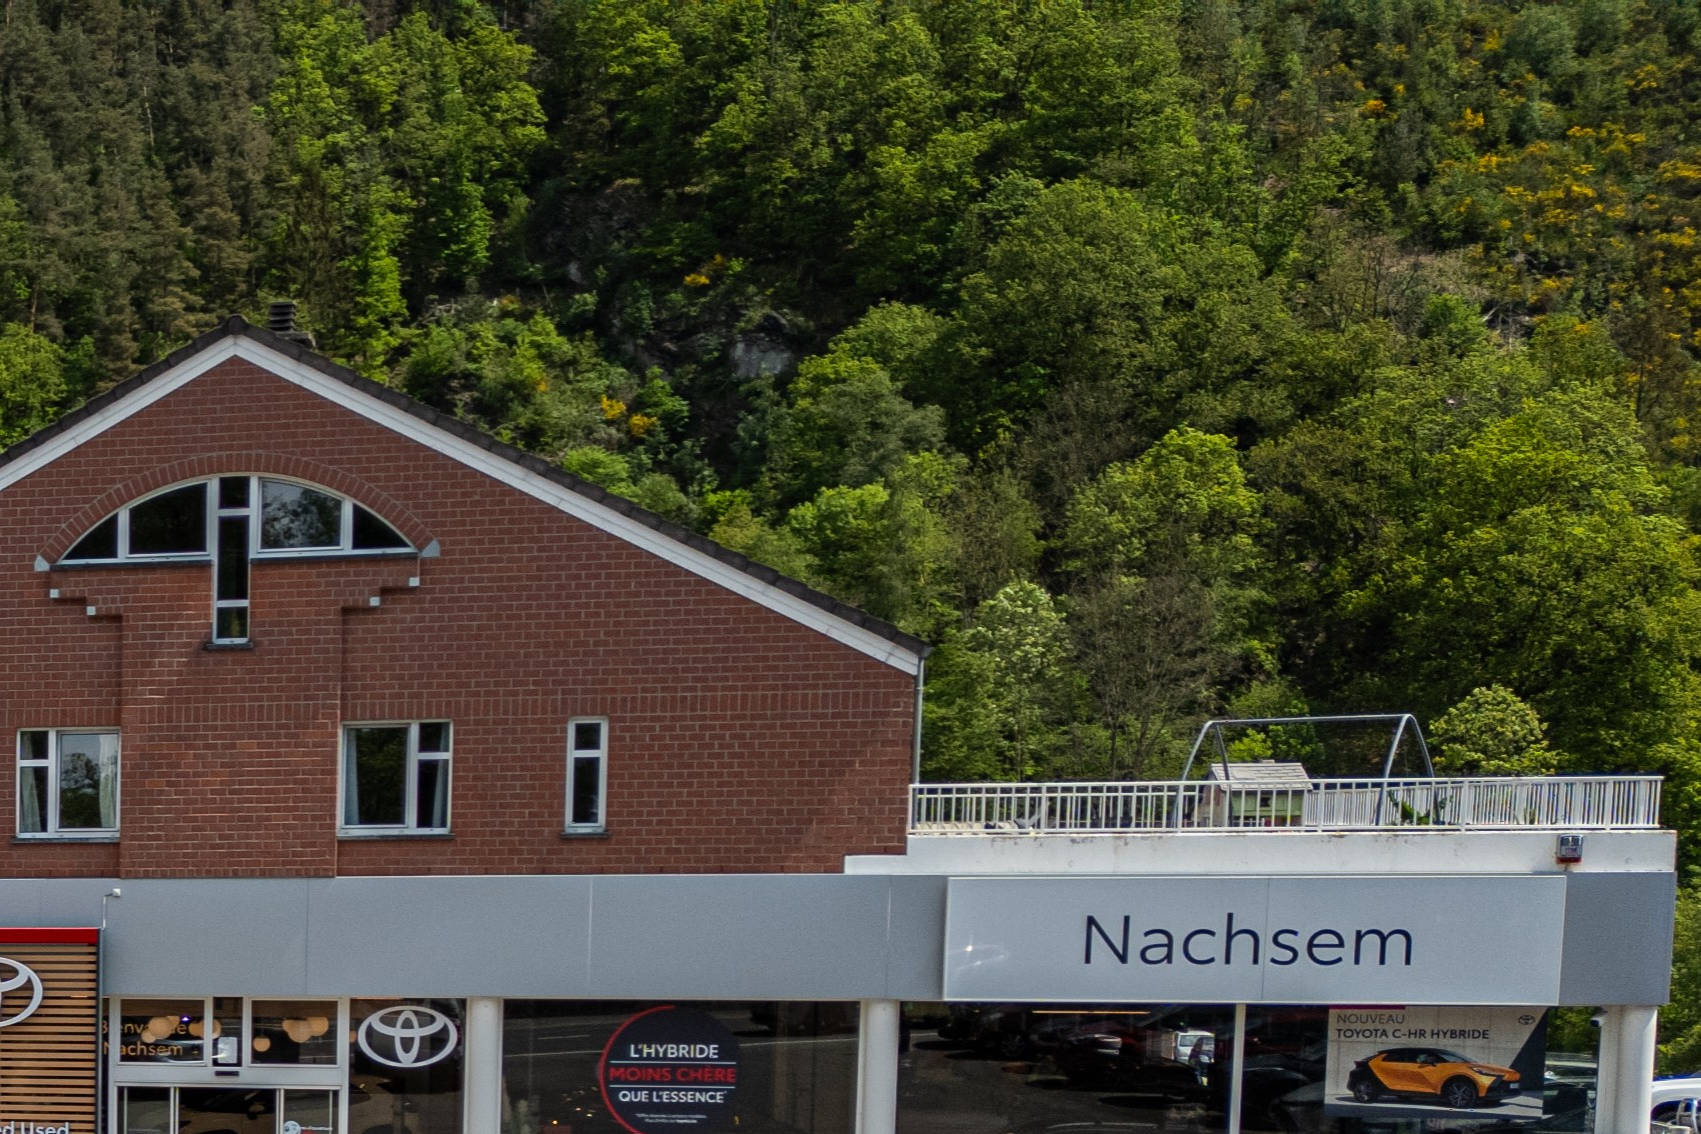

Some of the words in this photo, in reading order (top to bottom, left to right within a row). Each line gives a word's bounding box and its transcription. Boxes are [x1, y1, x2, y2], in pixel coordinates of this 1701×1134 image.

[1084, 912, 1413, 966] Nachsem
[1336, 1013, 1406, 1024] NOUVEAU
[1336, 1028, 1388, 1039] TOYOTA
[1392, 1028, 1427, 1039] C-HR
[1430, 1029, 1490, 1040] HYBRIDE
[630, 1044, 719, 1059] L'HYBRIDE
[609, 1066, 672, 1081] MOINS
[676, 1065, 737, 1083] CHÈRE
[619, 1090, 649, 1102] QUE
